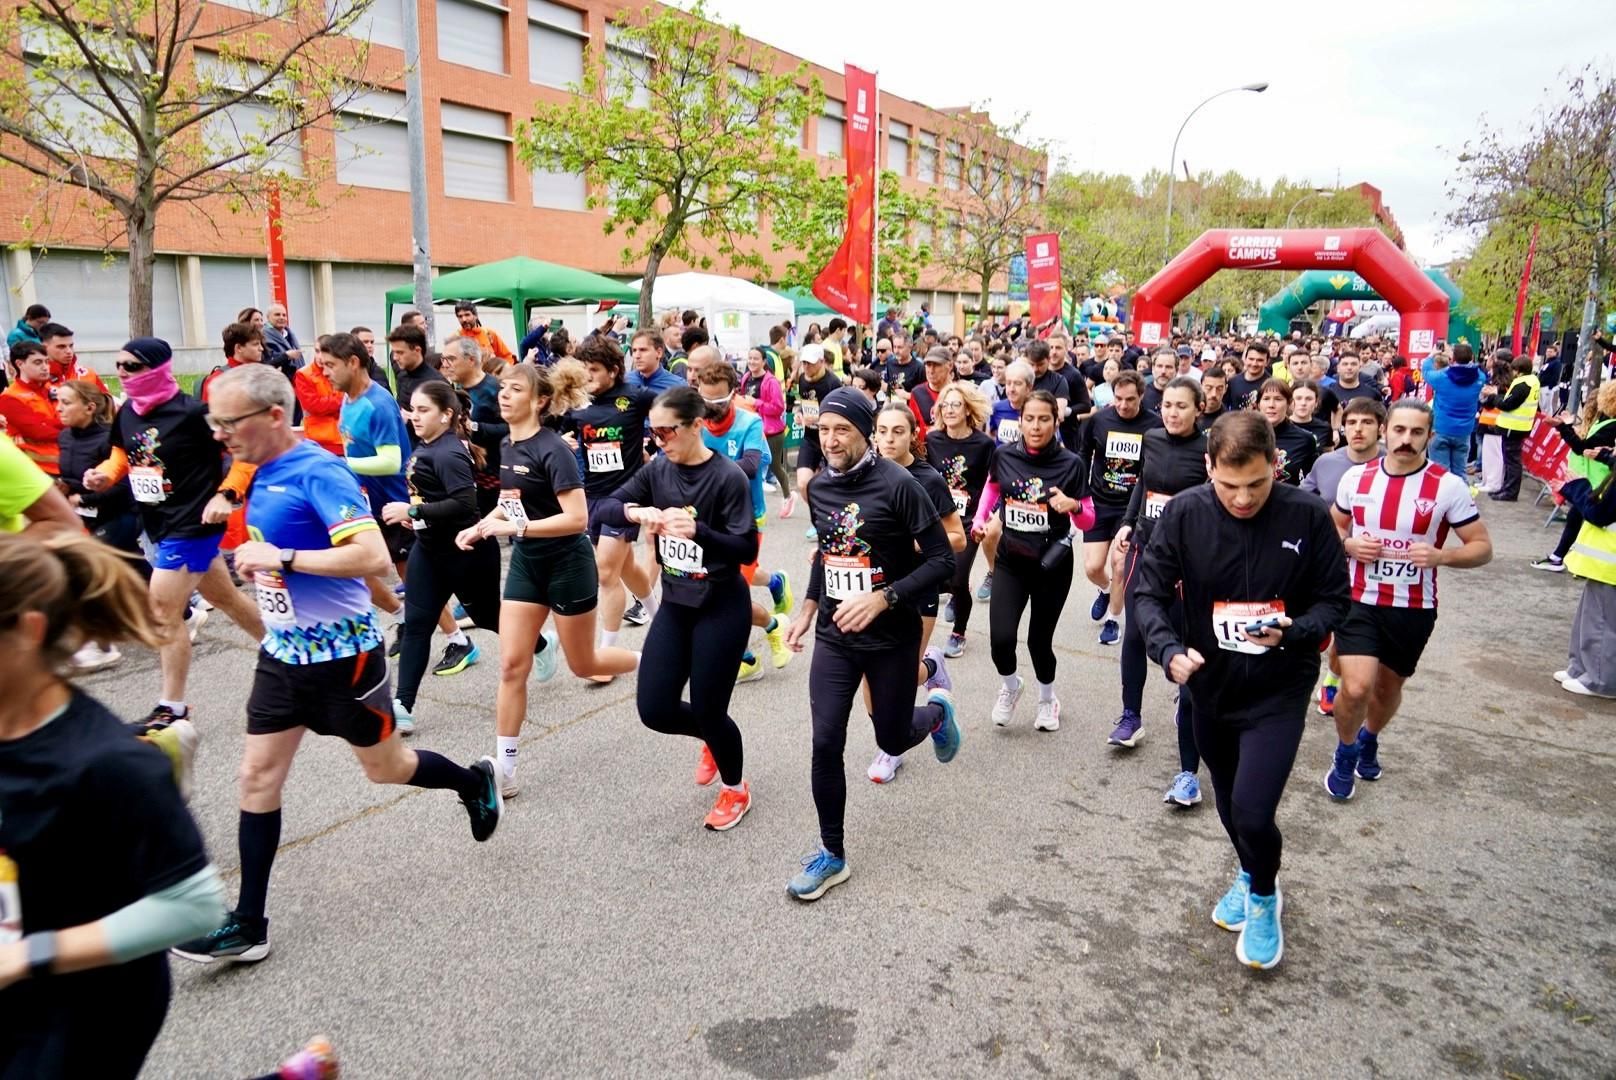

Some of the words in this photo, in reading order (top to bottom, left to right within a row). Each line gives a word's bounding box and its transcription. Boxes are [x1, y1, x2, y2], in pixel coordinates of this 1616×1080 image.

[1229, 236, 1283, 248] CARRERA
[1228, 247, 1277, 260] CAMPUS
[1361, 303, 1379, 312] LA
[1109, 441, 1139, 454] 1080
[590, 451, 618, 465] 1611
[1009, 508, 1045, 527] 1560
[662, 537, 699, 562] 1504
[1373, 560, 1418, 578] 1579
[827, 568, 865, 592] 3111
